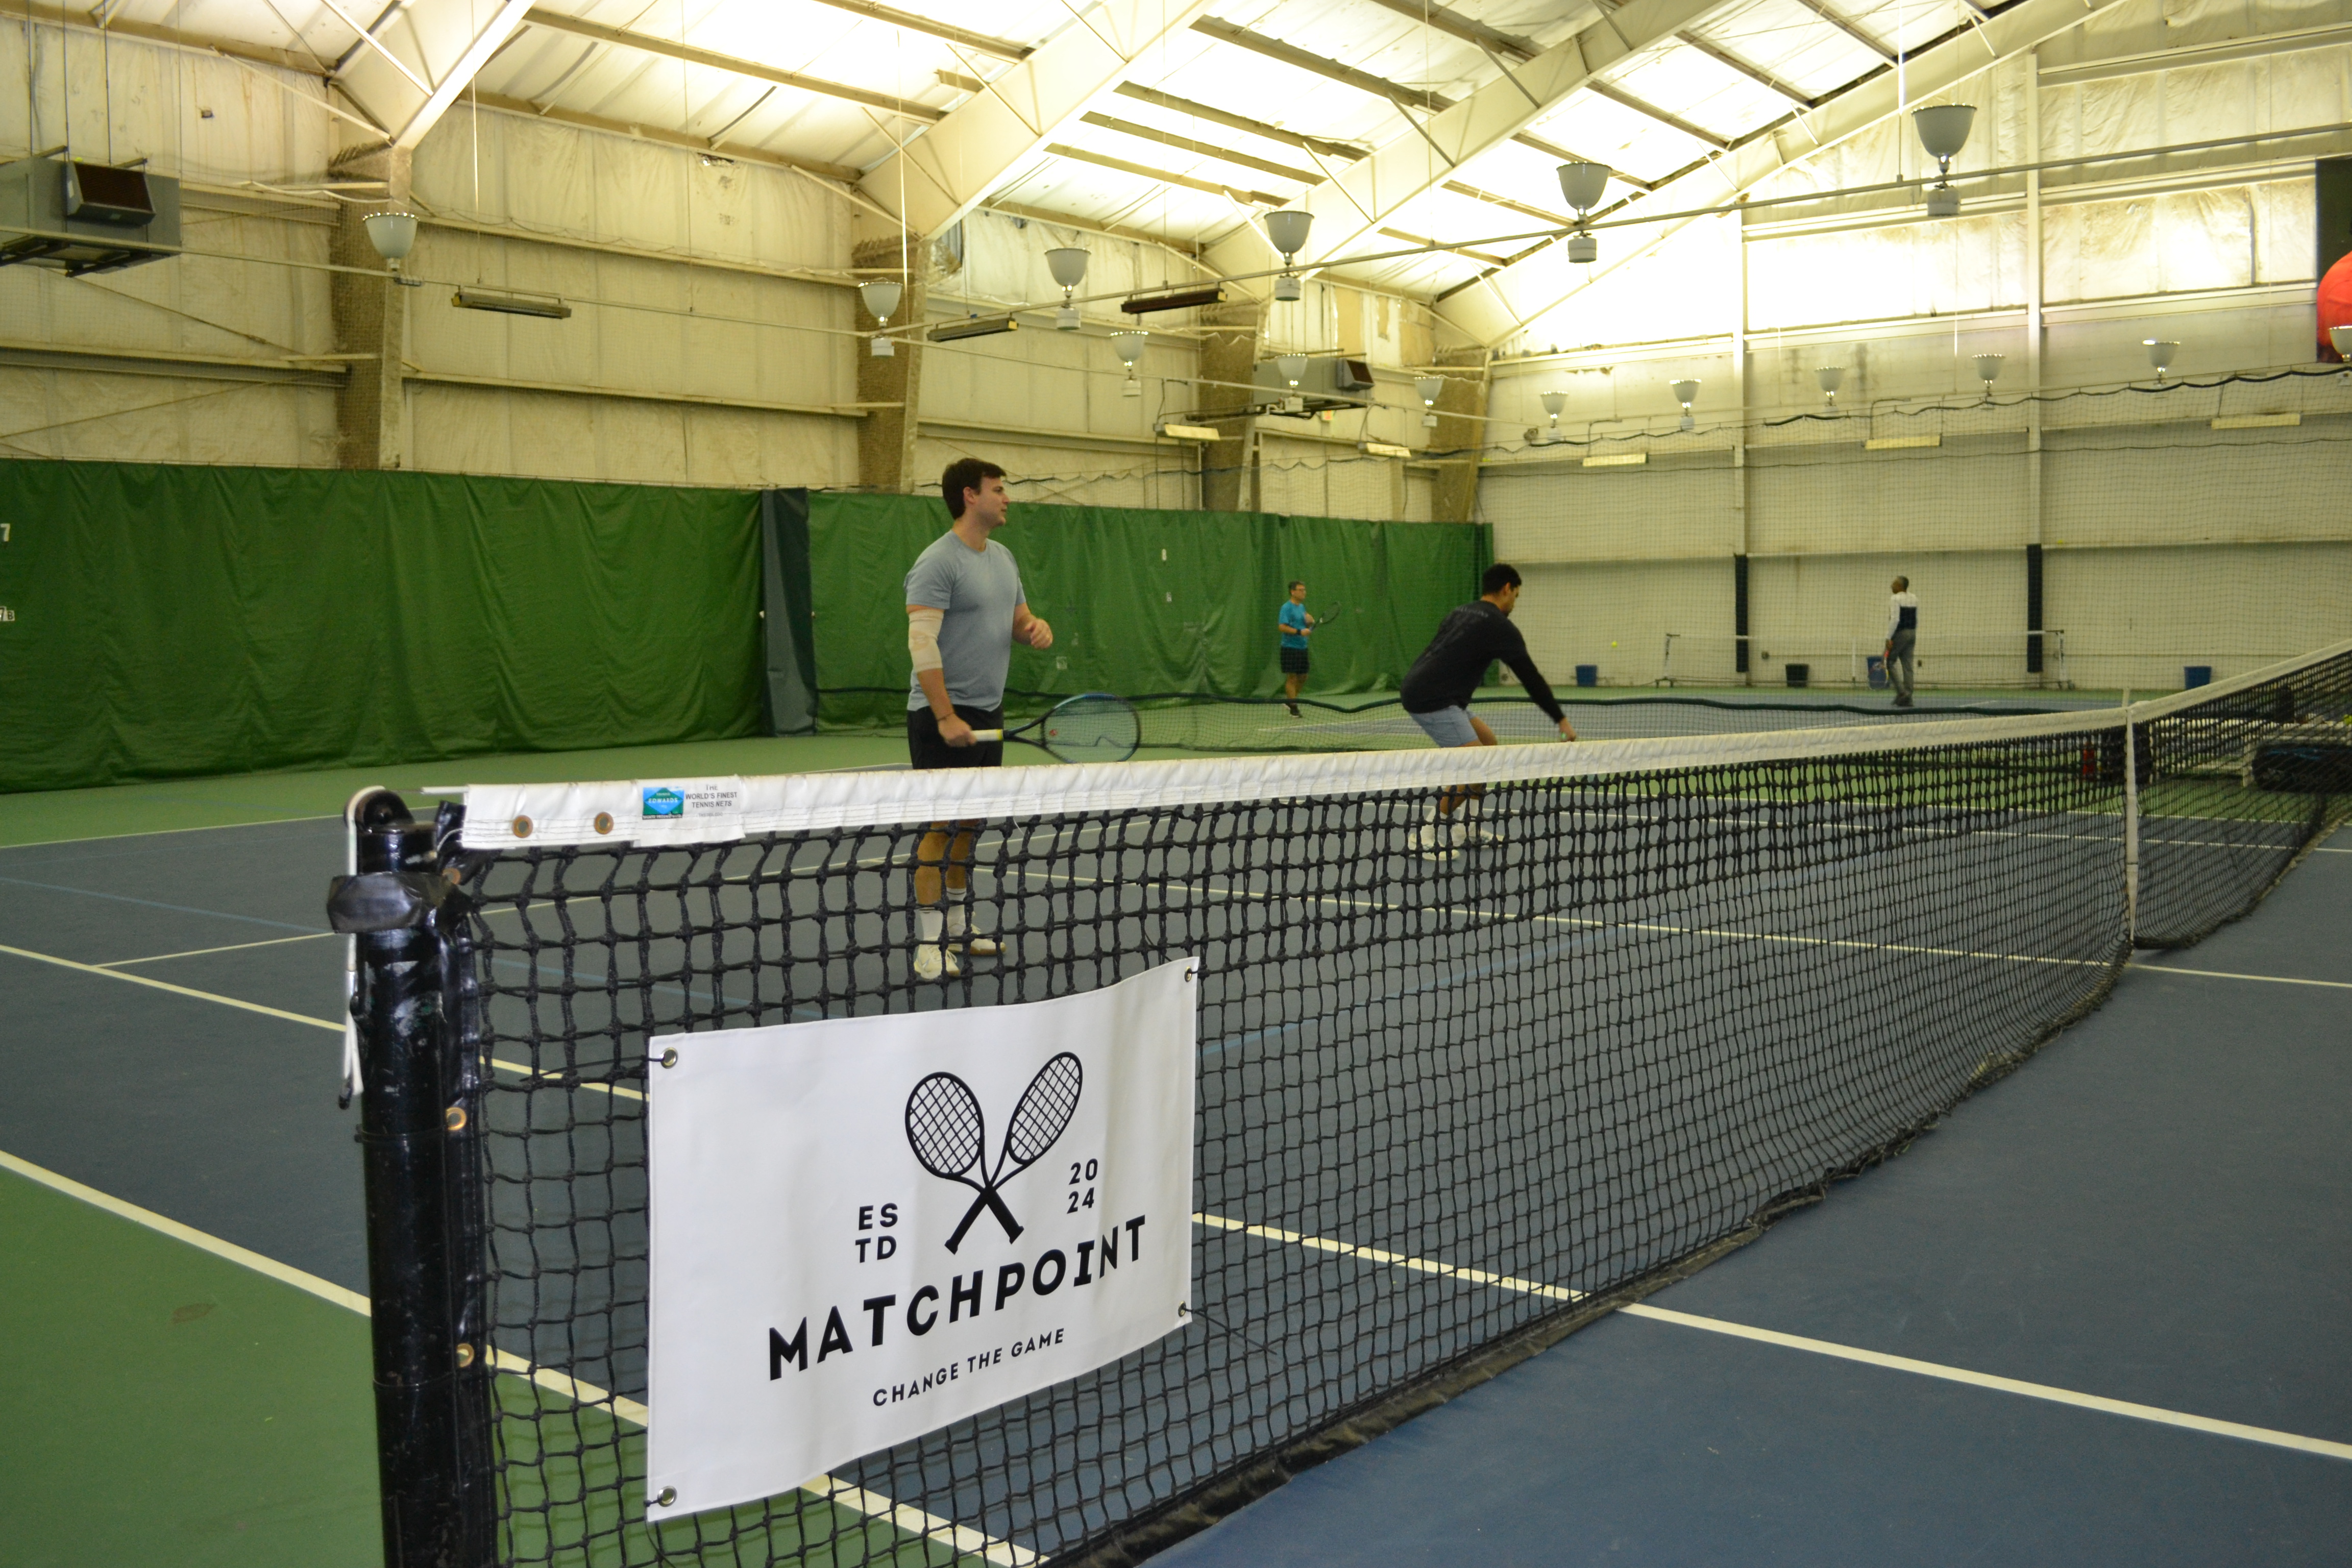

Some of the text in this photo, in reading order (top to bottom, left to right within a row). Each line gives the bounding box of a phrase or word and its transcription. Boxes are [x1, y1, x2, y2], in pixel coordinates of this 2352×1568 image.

[0, 523, 10, 542] 7
[1069, 1158, 1098, 1185] 20
[1066, 1187, 1094, 1214] 24
[859, 1203, 898, 1231] ES
[855, 1235, 897, 1263] TD
[769, 1214, 1145, 1381] MATCHPOINT
[873, 1328, 1064, 1406] CHANGE THE GAME
